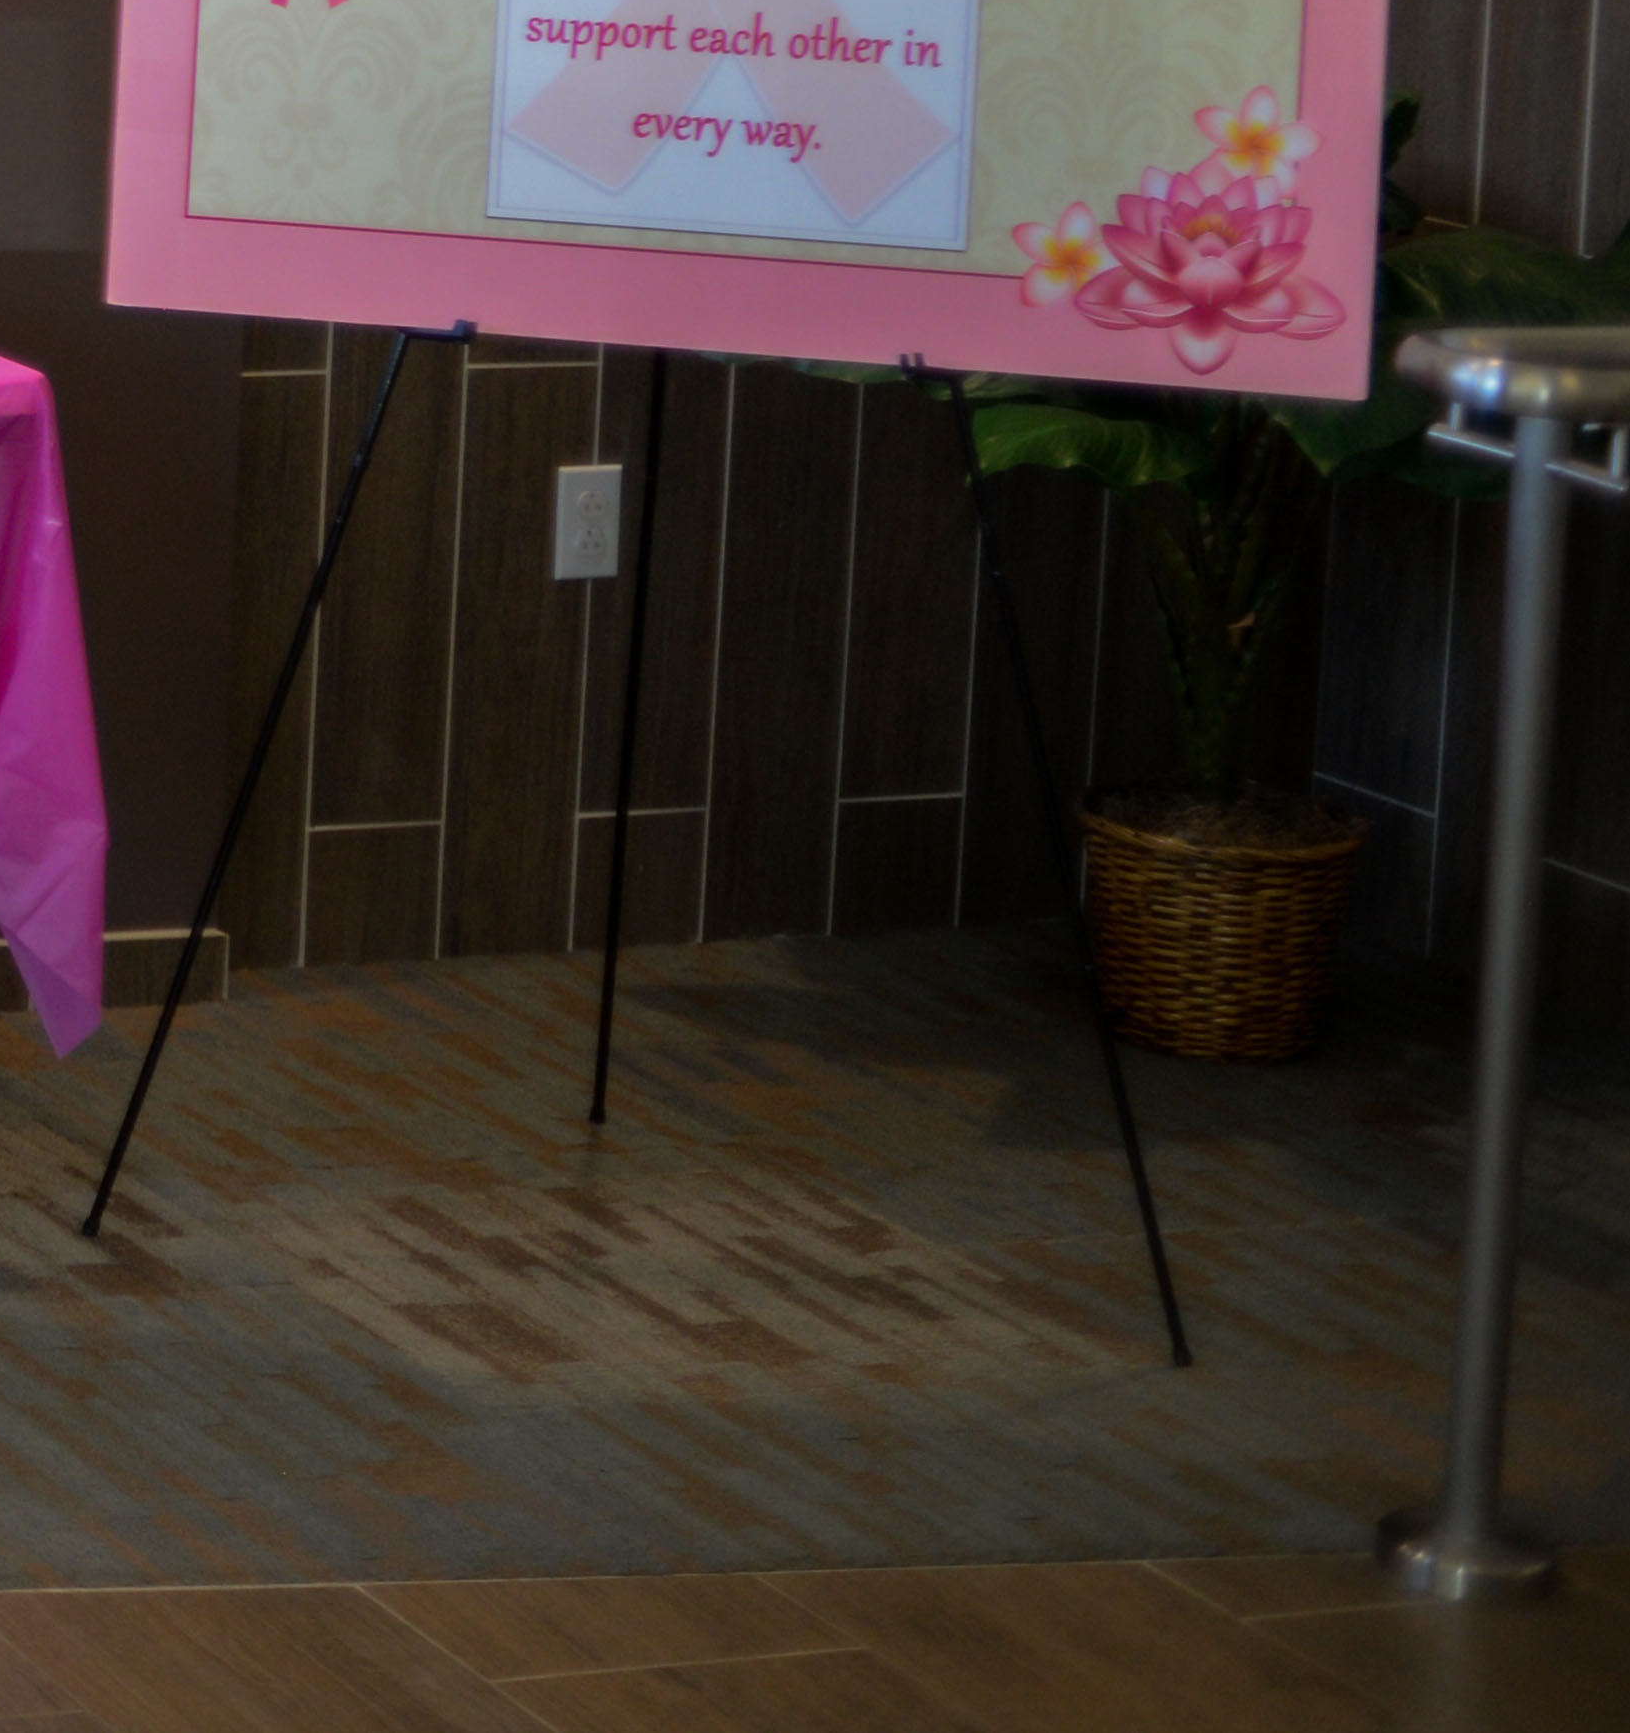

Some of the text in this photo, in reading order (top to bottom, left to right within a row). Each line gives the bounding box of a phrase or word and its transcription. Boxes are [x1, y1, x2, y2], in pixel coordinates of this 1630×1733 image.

[525, 12, 943, 67] support each other in
[632, 112, 822, 163] every way.
